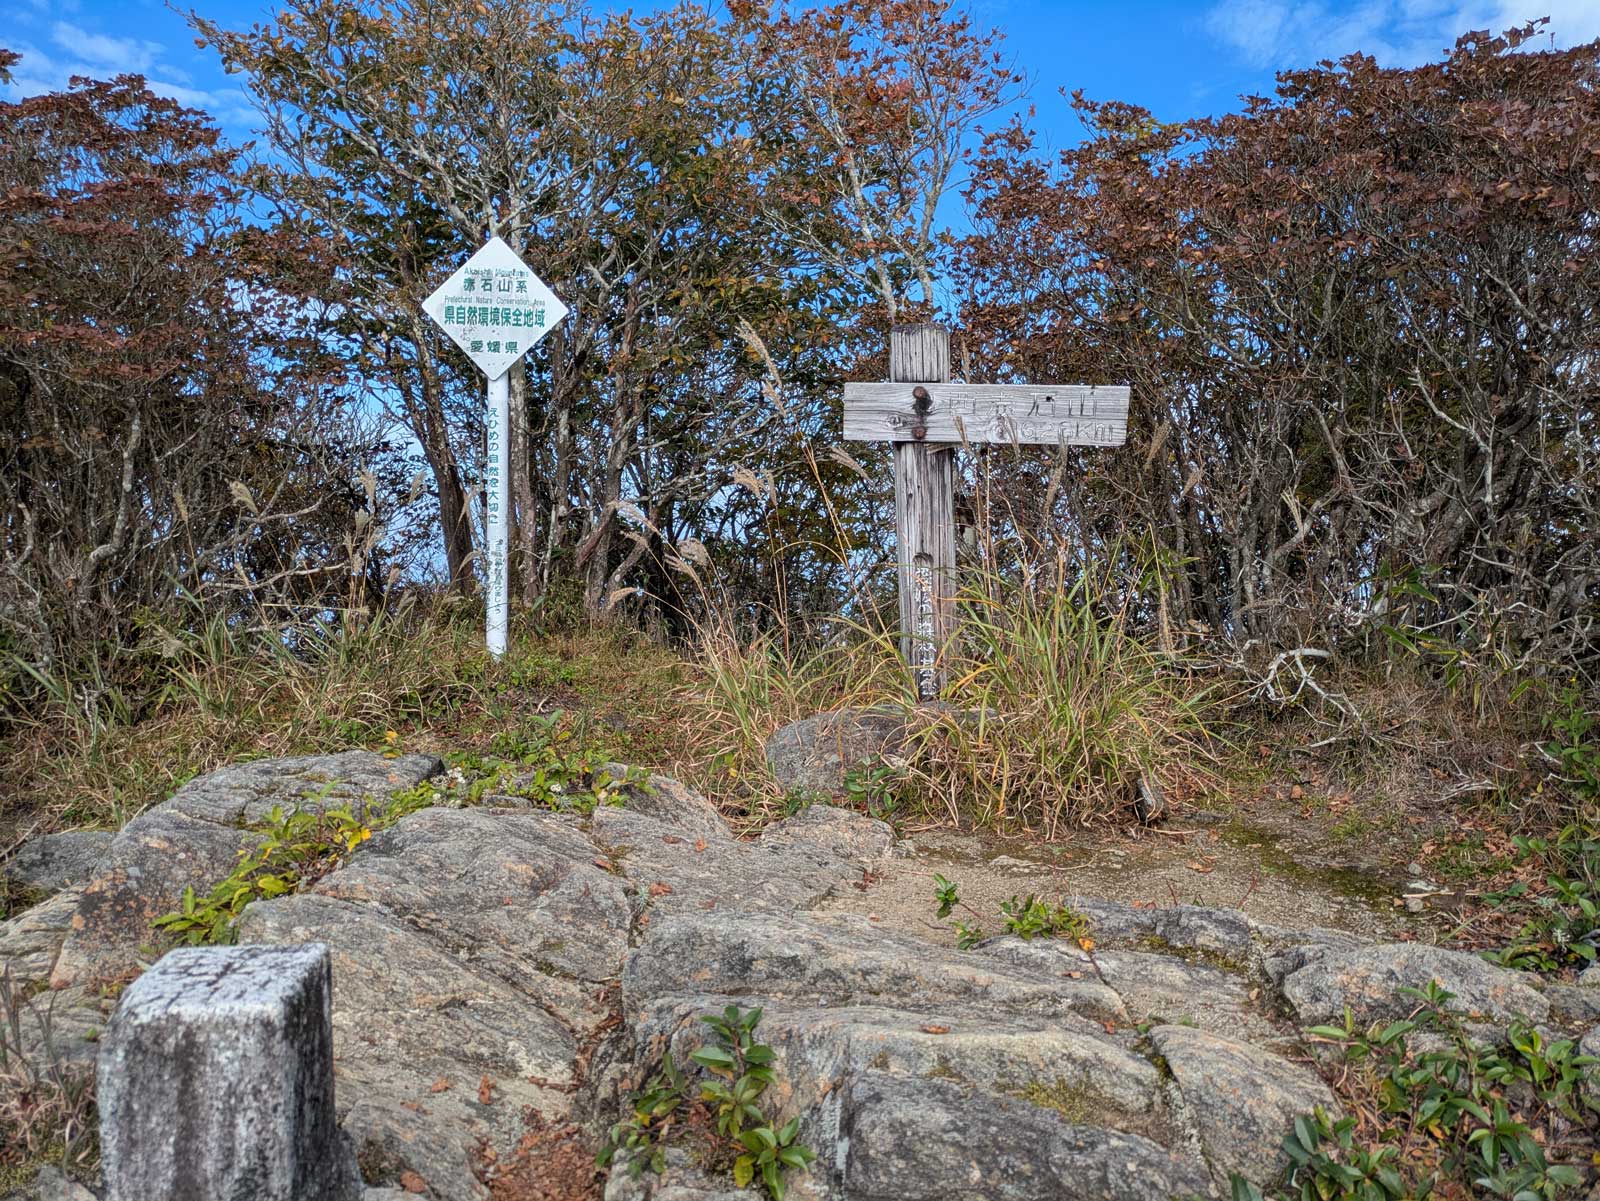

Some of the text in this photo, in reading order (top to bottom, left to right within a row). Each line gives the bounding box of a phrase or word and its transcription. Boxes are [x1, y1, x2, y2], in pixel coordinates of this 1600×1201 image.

[464, 277, 528, 293] 赤石山系
[475, 296, 493, 305] Nature
[496, 296, 529, 305] Conservation
[533, 298, 546, 306] Area
[444, 305, 546, 328] 県自然環境保全地域
[470, 340, 519, 354] 愛媛県
[488, 407, 500, 525] えひめの自然を大切に
